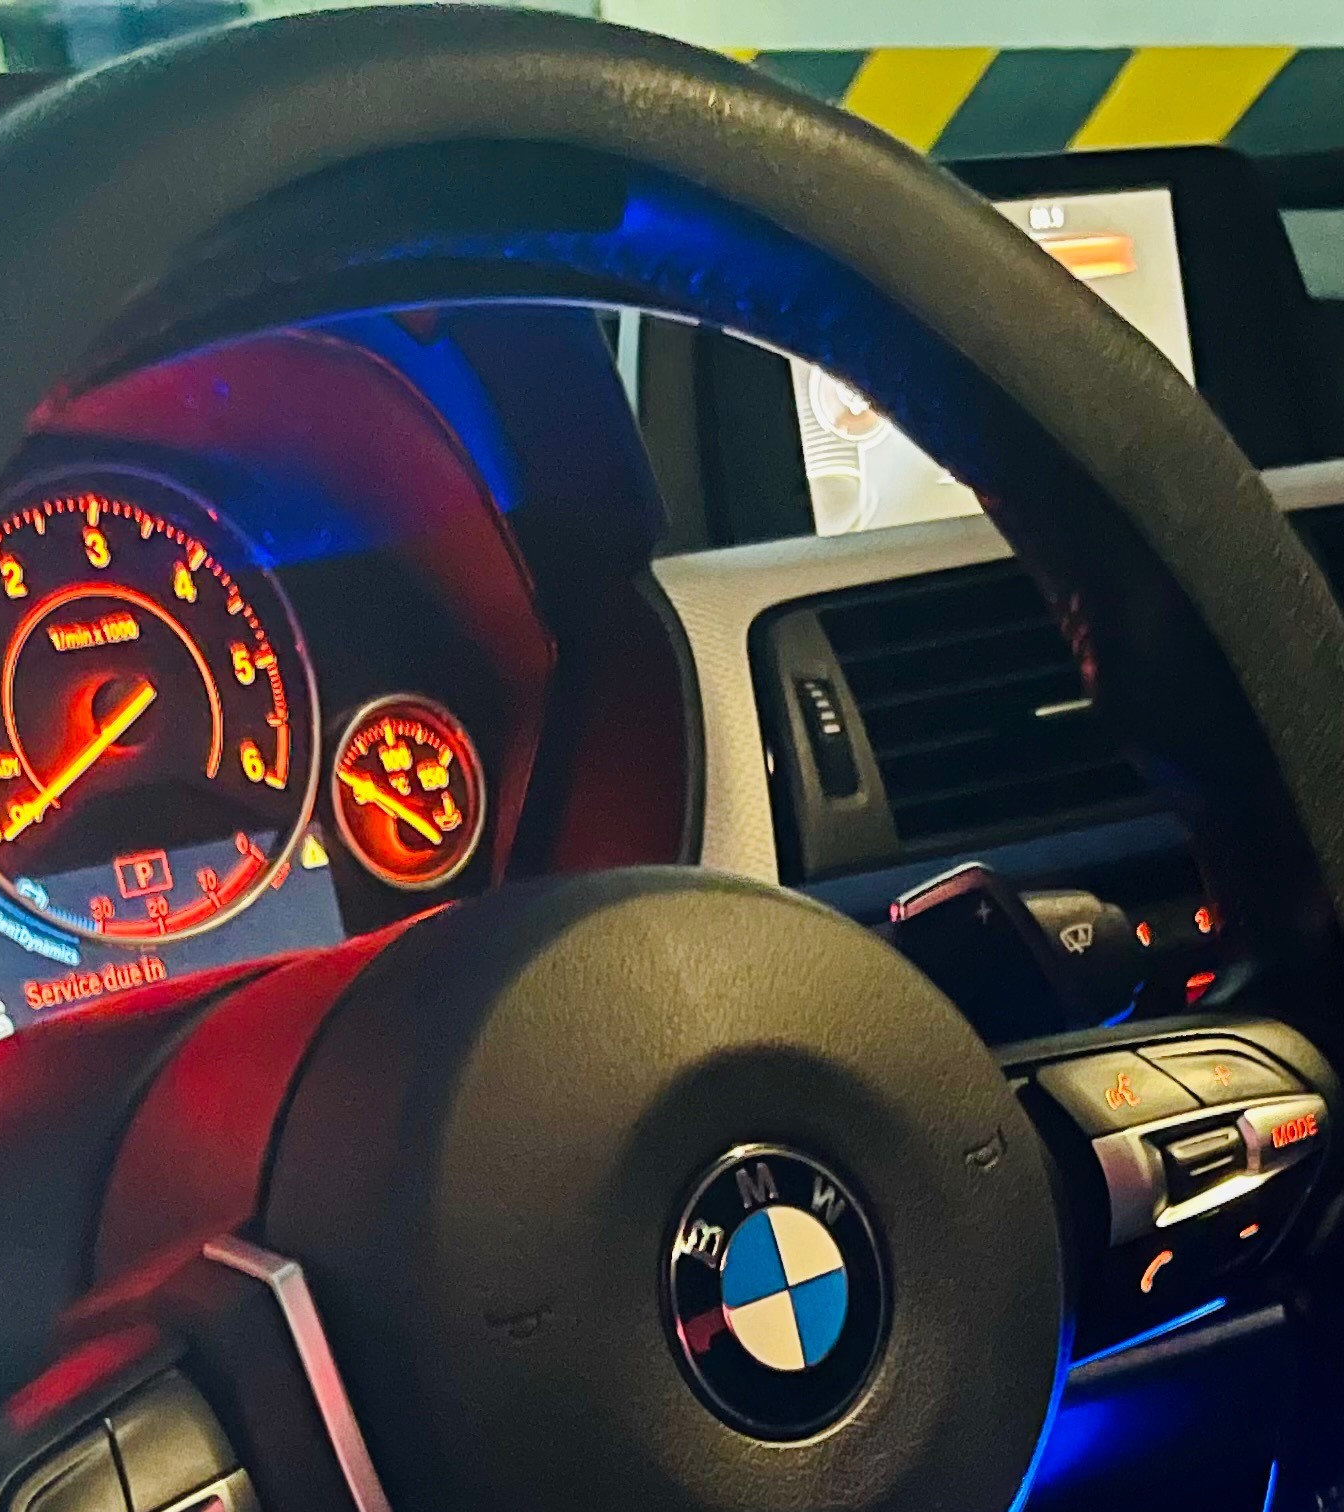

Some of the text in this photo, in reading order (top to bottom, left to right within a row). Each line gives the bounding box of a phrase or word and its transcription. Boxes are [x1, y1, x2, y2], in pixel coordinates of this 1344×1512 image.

[85, 529, 111, 568] 3
[2, 558, 28, 598] 2
[174, 565, 197, 603] 4
[102, 613, 140, 643] 1000
[232, 645, 256, 685] 5
[241, 745, 265, 783] 6
[134, 862, 154, 888] P
[25, 972, 103, 1010] Service
[103, 962, 142, 993] due
[1272, 1113, 1320, 1148] MODE
